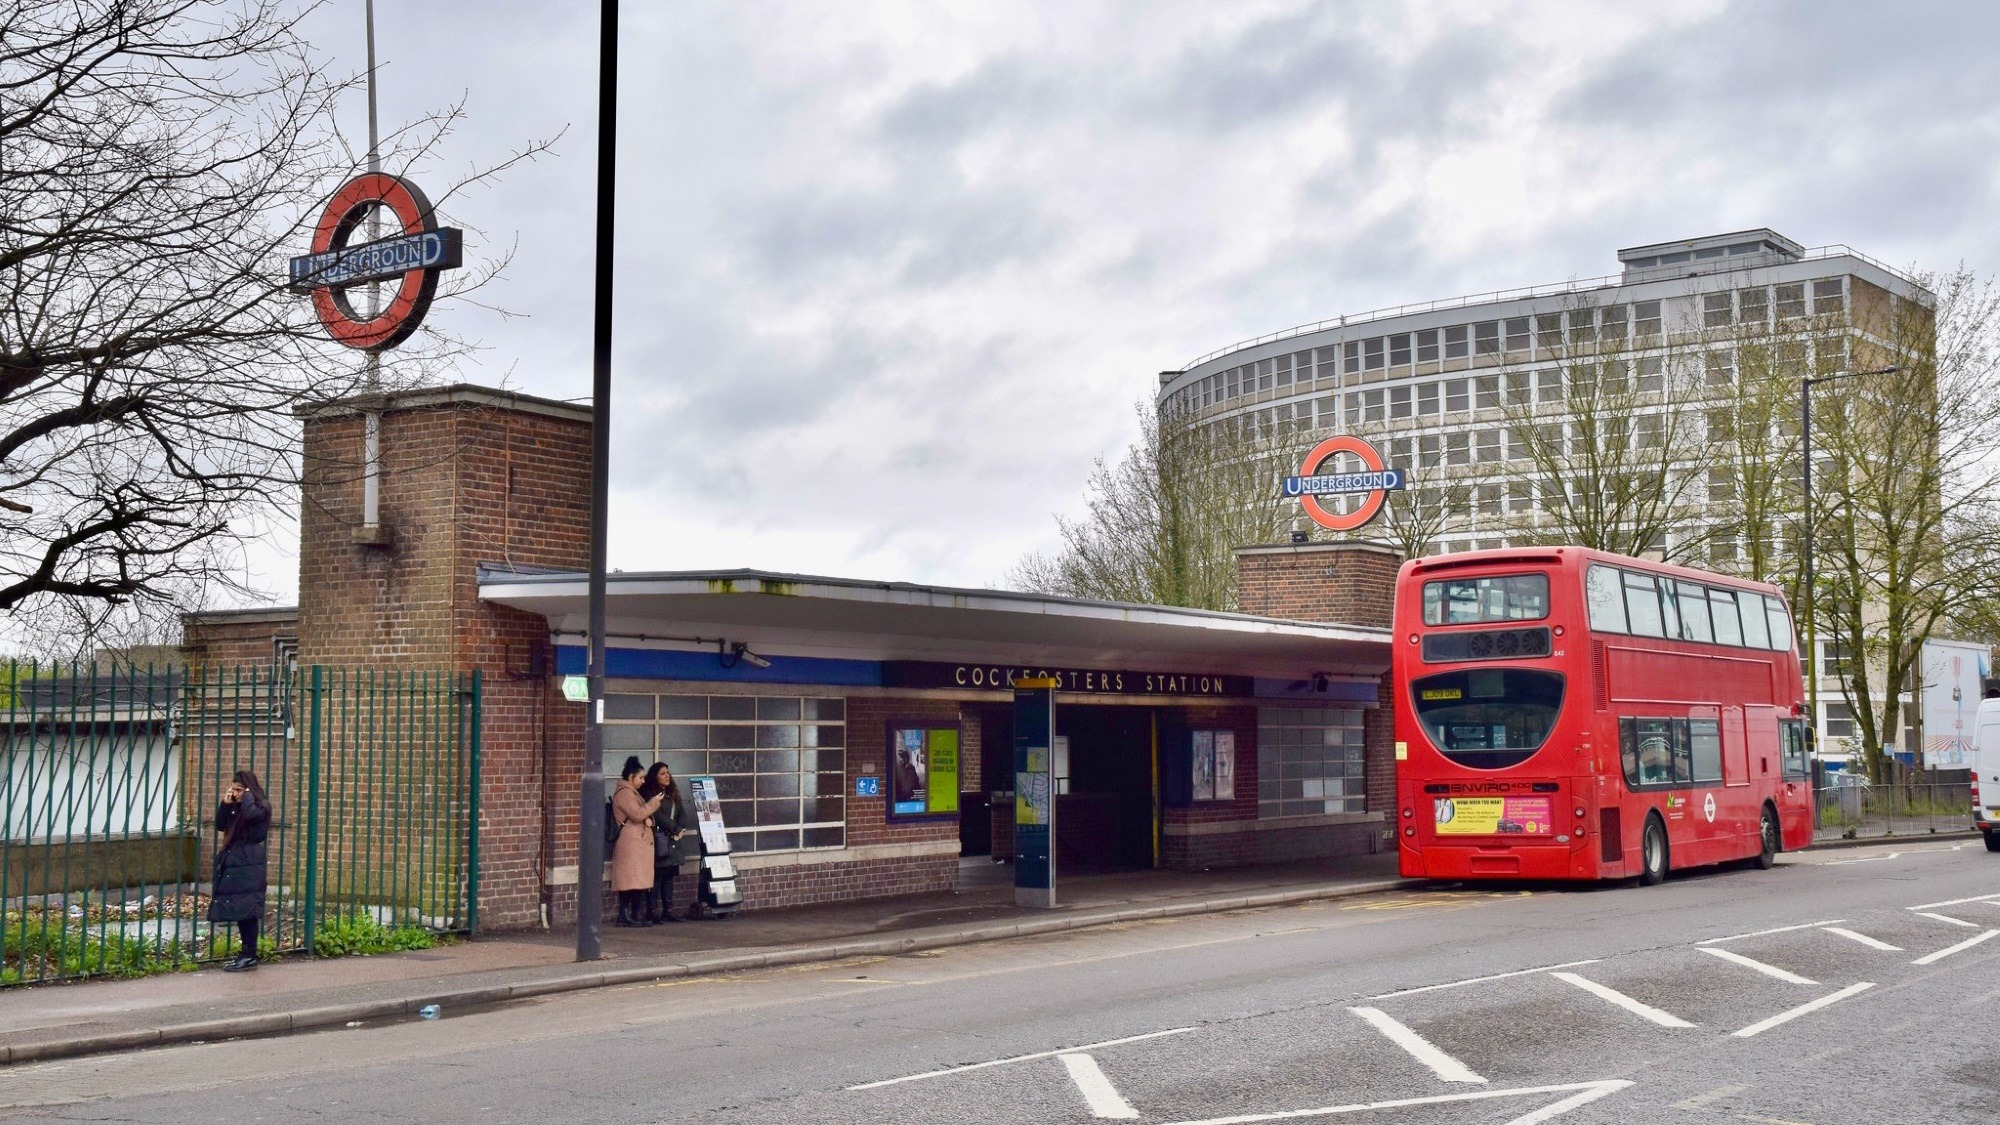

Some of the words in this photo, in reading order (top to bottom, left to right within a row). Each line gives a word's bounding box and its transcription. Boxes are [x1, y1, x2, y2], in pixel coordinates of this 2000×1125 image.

[294, 232, 441, 287] UNDERGROUND
[1287, 471, 1398, 495] UNDERGROUND
[1146, 674, 1222, 693] STATION
[1451, 782, 1510, 792] ENVIRO
